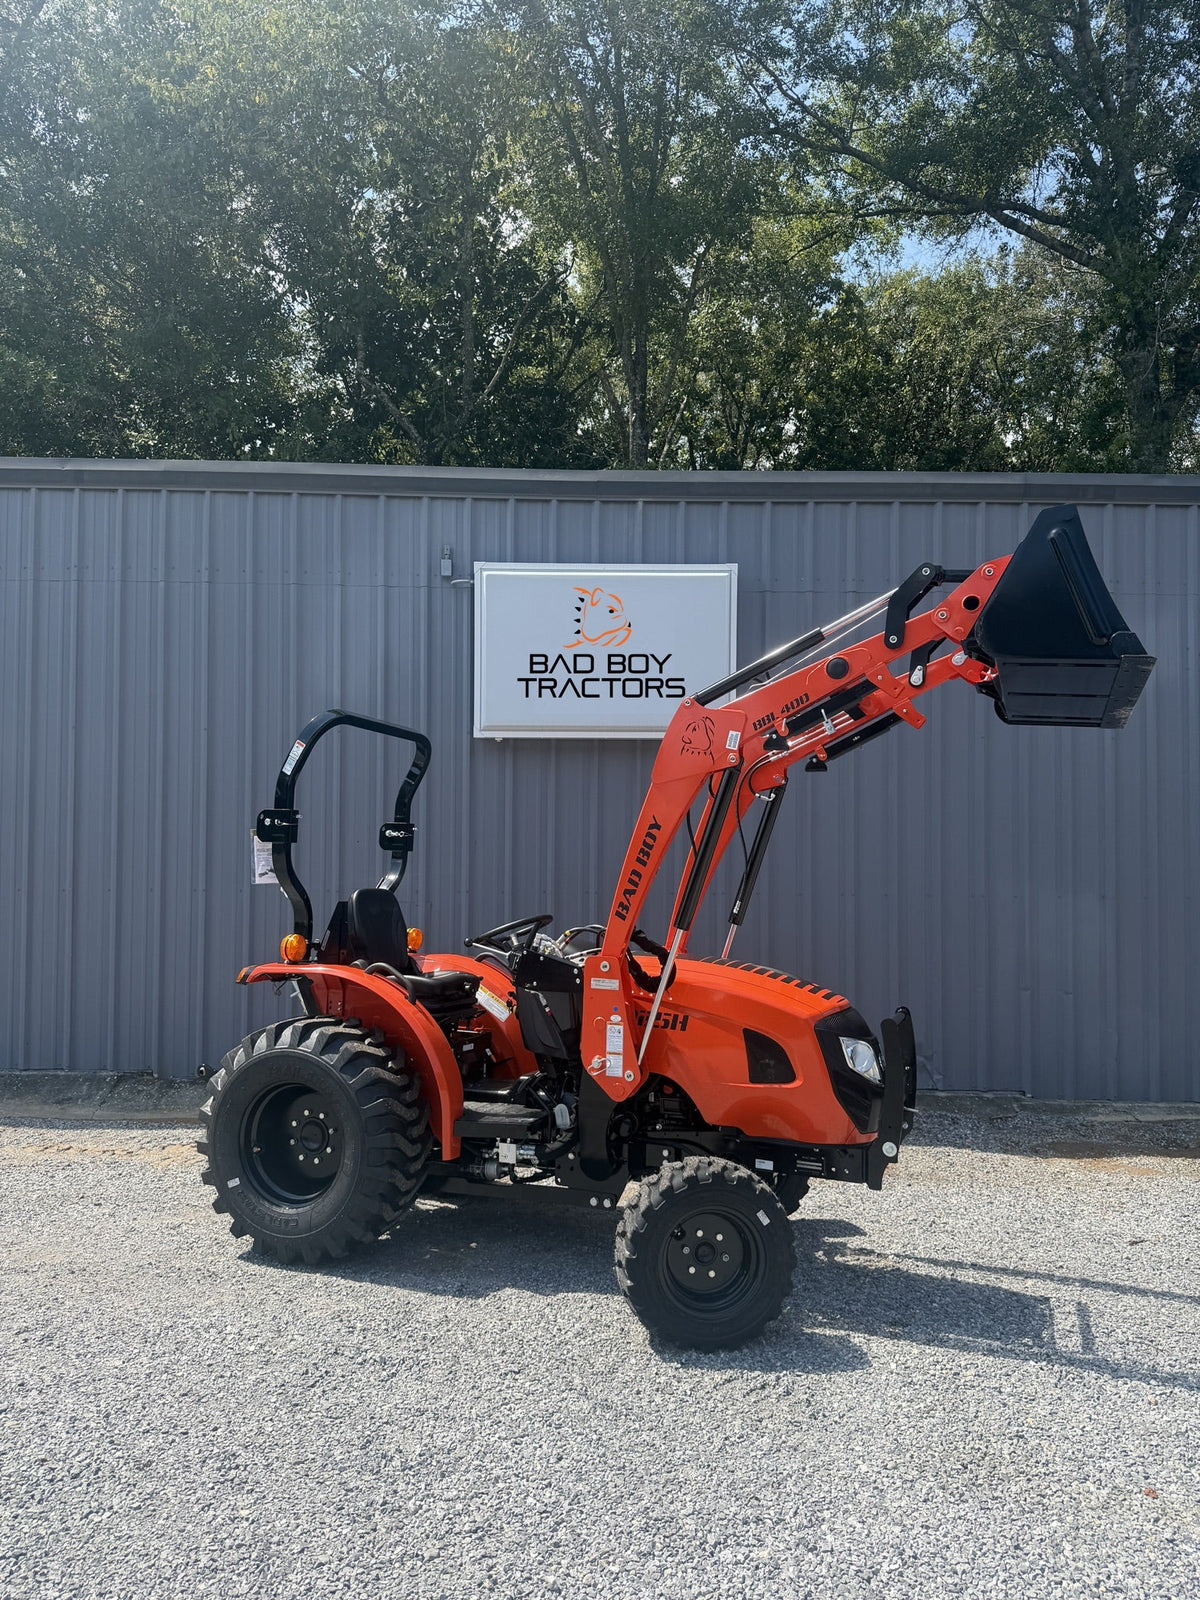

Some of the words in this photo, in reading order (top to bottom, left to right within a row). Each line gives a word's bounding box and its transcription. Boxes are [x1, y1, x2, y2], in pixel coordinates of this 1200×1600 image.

[529, 653, 595, 674] BAD
[607, 653, 673, 674] BOY
[516, 677, 686, 698] TRACTORS
[752, 711, 780, 731] BBL
[780, 692, 810, 713] 400
[614, 868, 643, 922] BAD
[635, 814, 662, 868] BOY
